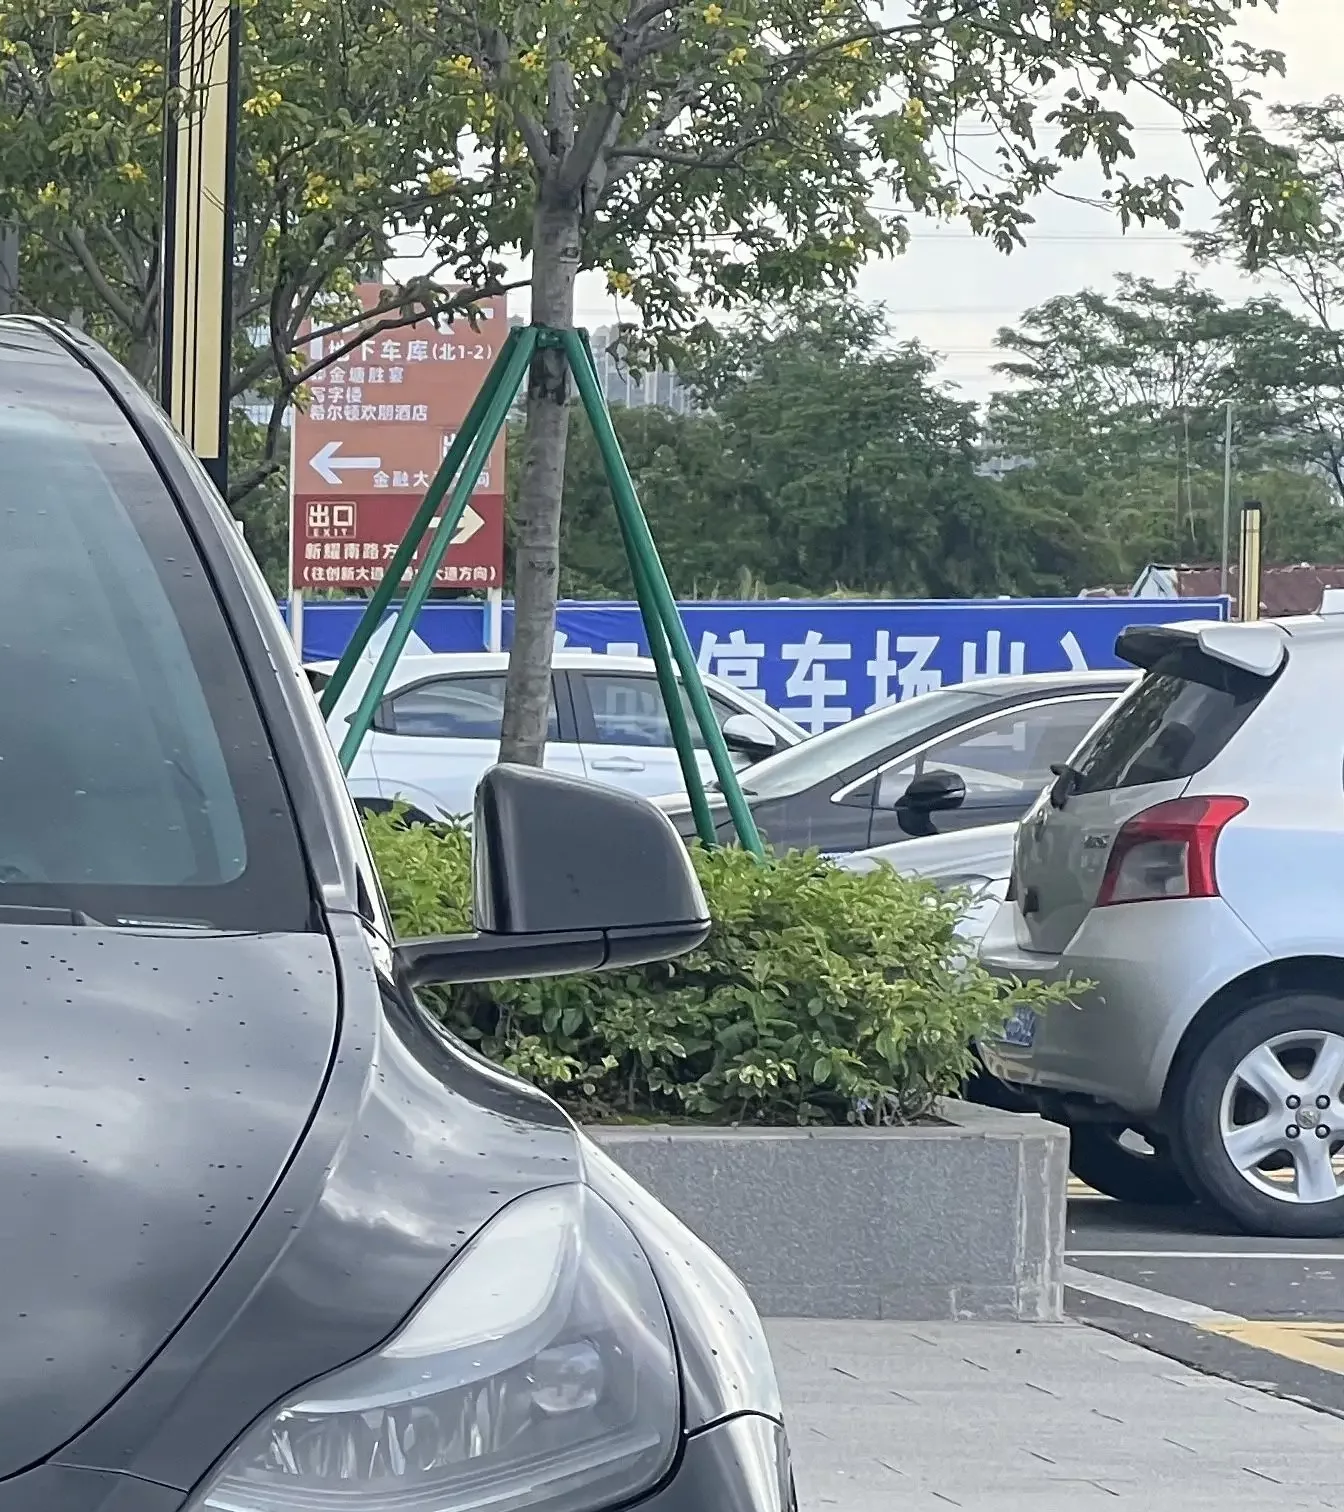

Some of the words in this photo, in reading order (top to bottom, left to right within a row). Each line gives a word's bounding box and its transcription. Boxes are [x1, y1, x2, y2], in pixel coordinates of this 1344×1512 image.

[373, 470, 490, 488] 金融大向
[308, 504, 354, 527] 出口
[313, 528, 349, 537] EXIT
[304, 542, 418, 560] 新耀南路方
